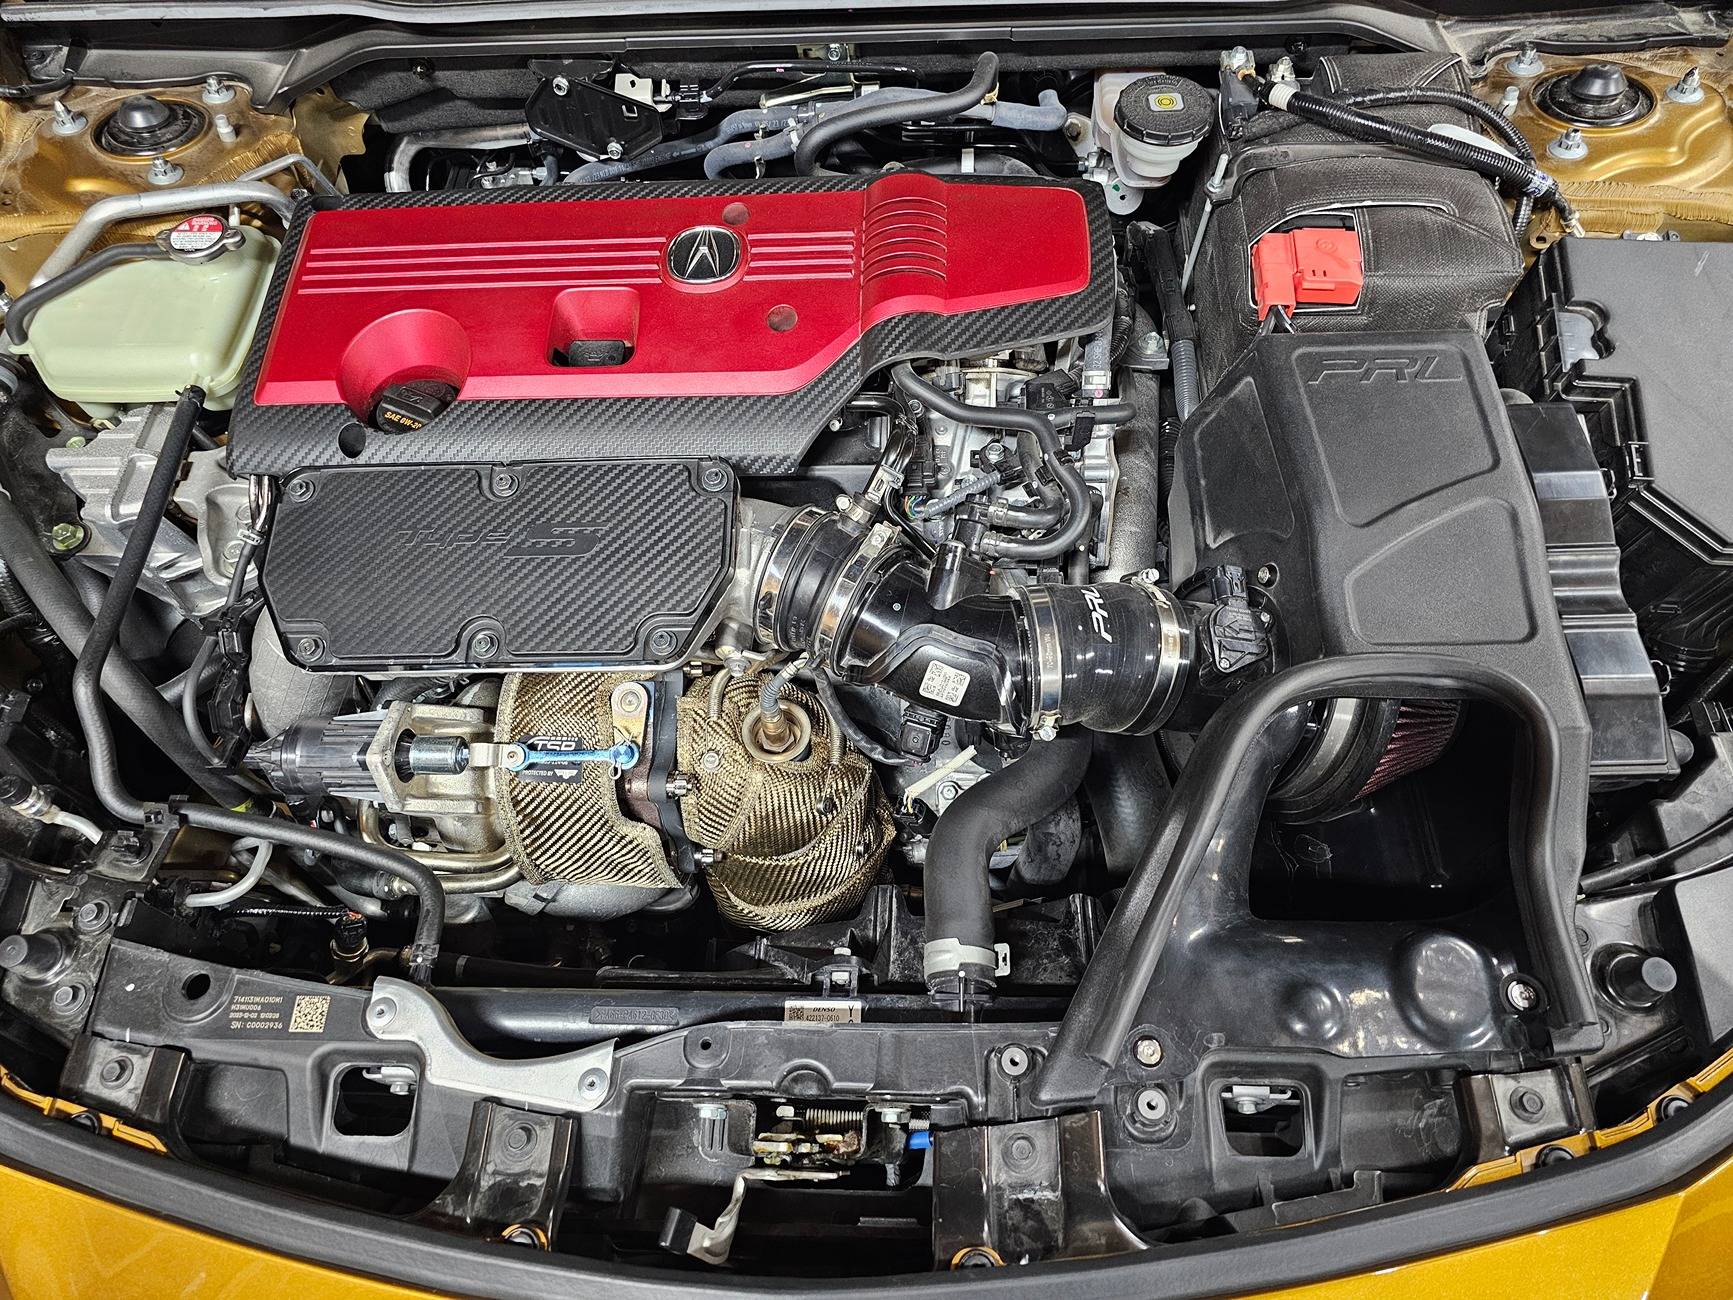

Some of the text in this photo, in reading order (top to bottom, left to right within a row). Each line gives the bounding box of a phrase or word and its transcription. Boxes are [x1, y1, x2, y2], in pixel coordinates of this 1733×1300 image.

[1307, 354, 1462, 384] PRL
[384, 411, 401, 422] SAE
[230, 1020, 245, 1029] SN:
